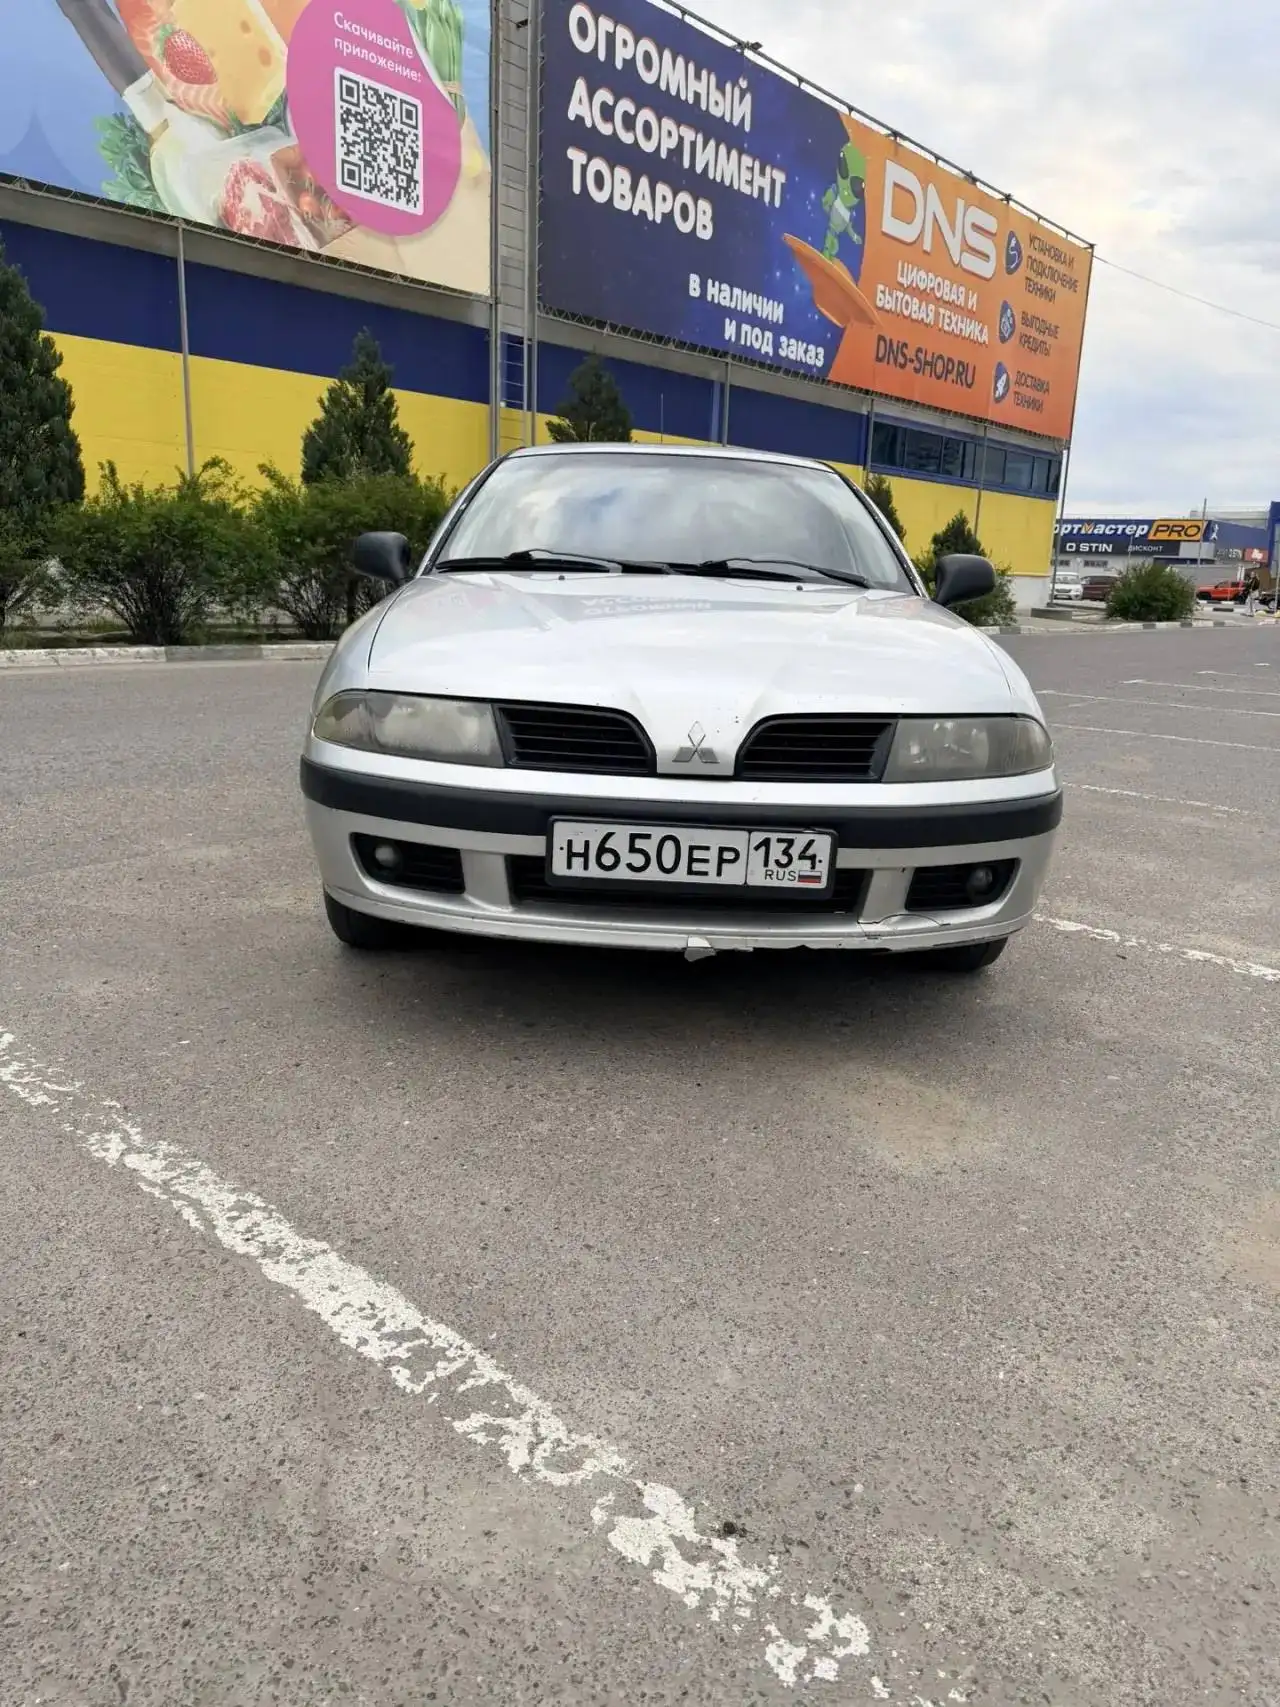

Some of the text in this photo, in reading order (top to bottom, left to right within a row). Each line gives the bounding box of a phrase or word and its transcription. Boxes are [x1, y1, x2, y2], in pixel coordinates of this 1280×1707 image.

[333, 11, 414, 58] Скачивайте
[334, 37, 422, 83] приложение:
[568, 3, 752, 133] ОГРОМНЫЙ
[567, 76, 786, 208] АССОРТИМЕНТ
[566, 146, 714, 240] ТОВАРОВ
[881, 158, 998, 281] DNS
[1026, 254, 1078, 293] ПОДКЛЮЧЕНИЕ
[1029, 232, 1075, 270] УСТАНОВКА И
[706, 278, 784, 324] наличии
[897, 259, 978, 312] ЦИФРОВАЯ И
[1024, 276, 1056, 304] ТЕХНИКИ
[876, 283, 989, 346] БЫТОВАЯ ТЕХНИКА
[1021, 311, 1060, 339] ВЫГОДНЫЕ
[724, 317, 825, 368] и под заказ
[875, 334, 976, 389] DNS-SHOP.RU
[1019, 331, 1051, 356] КРЕДИТЫ
[1013, 391, 1044, 414] ТЕХНИКИ
[1015, 370, 1050, 396] ДОСТАВКА
[1079, 543, 1113, 553] STIN
[1152, 524, 1201, 538] PRO
[565, 831, 817, 877] Н650ЕР 134
[764, 869, 797, 882] RUS
